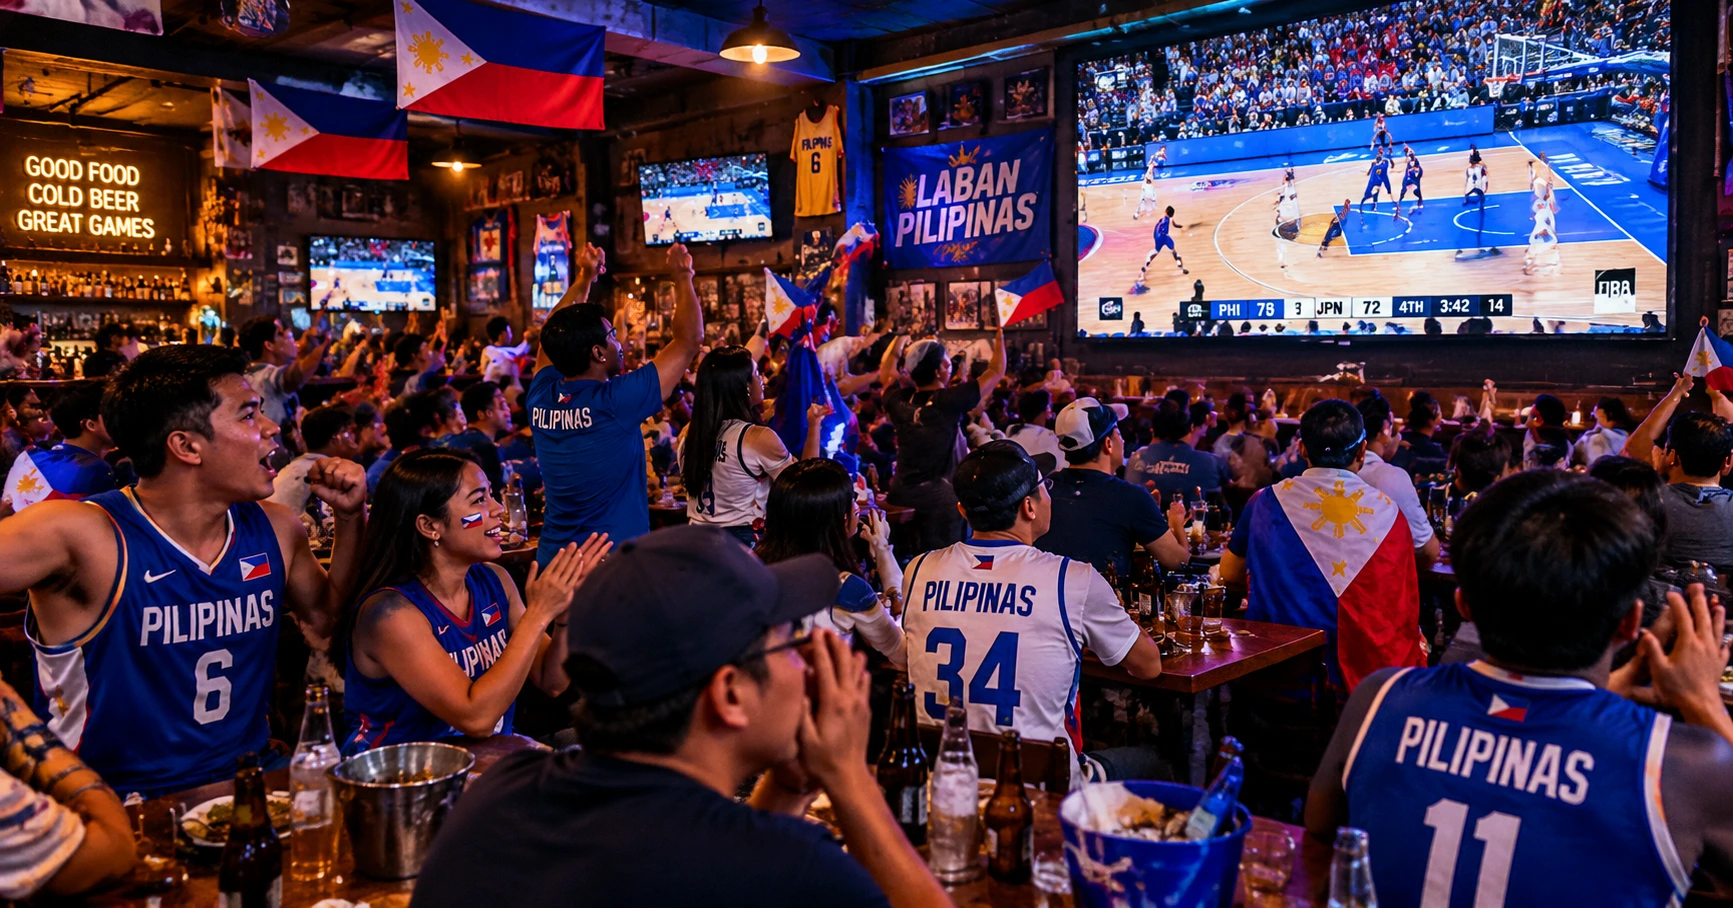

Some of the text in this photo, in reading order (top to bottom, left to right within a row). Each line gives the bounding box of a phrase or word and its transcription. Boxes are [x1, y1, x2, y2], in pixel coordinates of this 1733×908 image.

[25, 155, 140, 186] GOOD FOOD
[811, 152, 821, 174] 6
[916, 158, 1021, 208] LABAN
[28, 183, 140, 212] COLD BEER
[18, 209, 155, 239] GREAT GAMES
[895, 192, 1038, 247] PILIPINAS
[1218, 303, 1241, 317] PHI
[1316, 301, 1343, 315] JPN
[1363, 300, 1381, 314] 72
[1399, 300, 1424, 314] 4TH
[1440, 298, 1470, 313] 3:42
[1488, 298, 1504, 312] 14
[532, 406, 593, 430] PILIPINAS
[140, 589, 274, 646] PILIPINAS
[923, 580, 1037, 617] PILIPINAS
[193, 648, 233, 725] 6
[924, 627, 1021, 727] 34
[1395, 716, 1595, 805] PILIPINAS
[1420, 798, 1521, 908] 11
